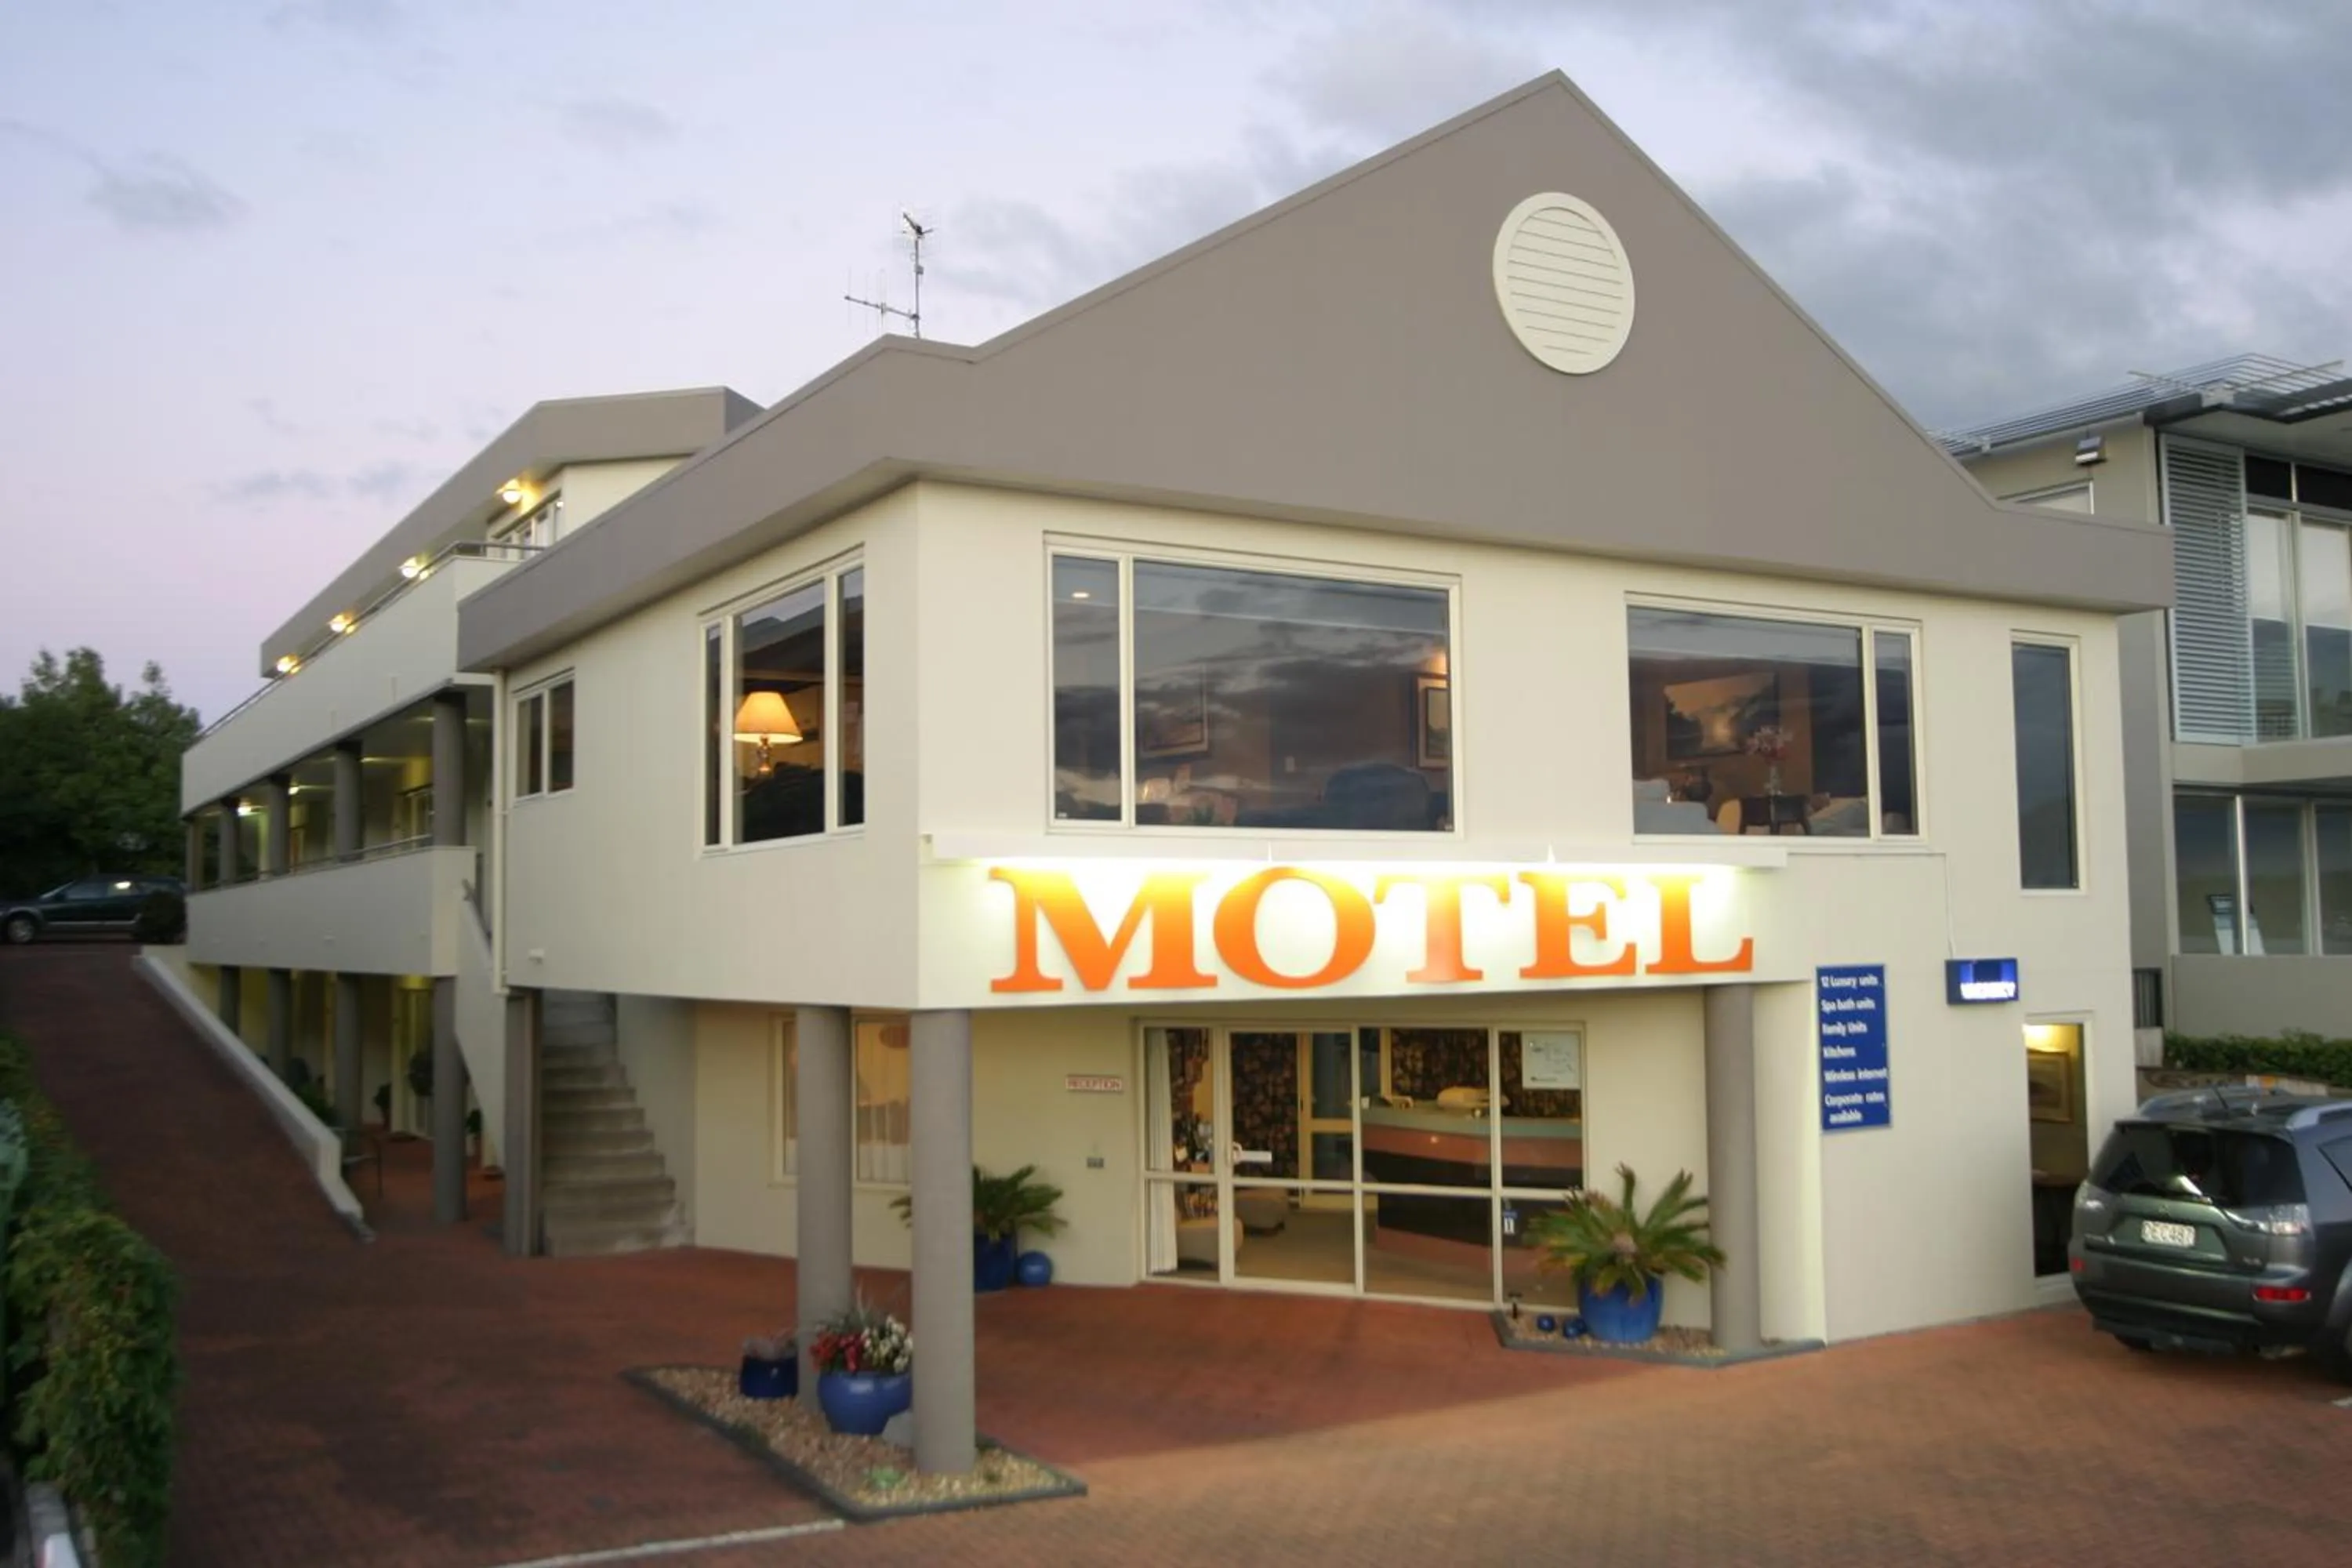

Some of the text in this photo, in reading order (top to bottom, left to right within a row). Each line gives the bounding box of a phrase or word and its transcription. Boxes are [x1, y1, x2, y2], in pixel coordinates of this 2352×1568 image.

[989, 866, 1753, 993] MOTEL
[1831, 975, 1857, 989] Luxury
[1821, 1000, 1835, 1013] Spa
[1837, 998, 1855, 1010] bath
[1822, 1022, 1846, 1036] Family
[1824, 1069, 1856, 1083] Wireless
[1824, 1091, 1885, 1108] Corporate rates
